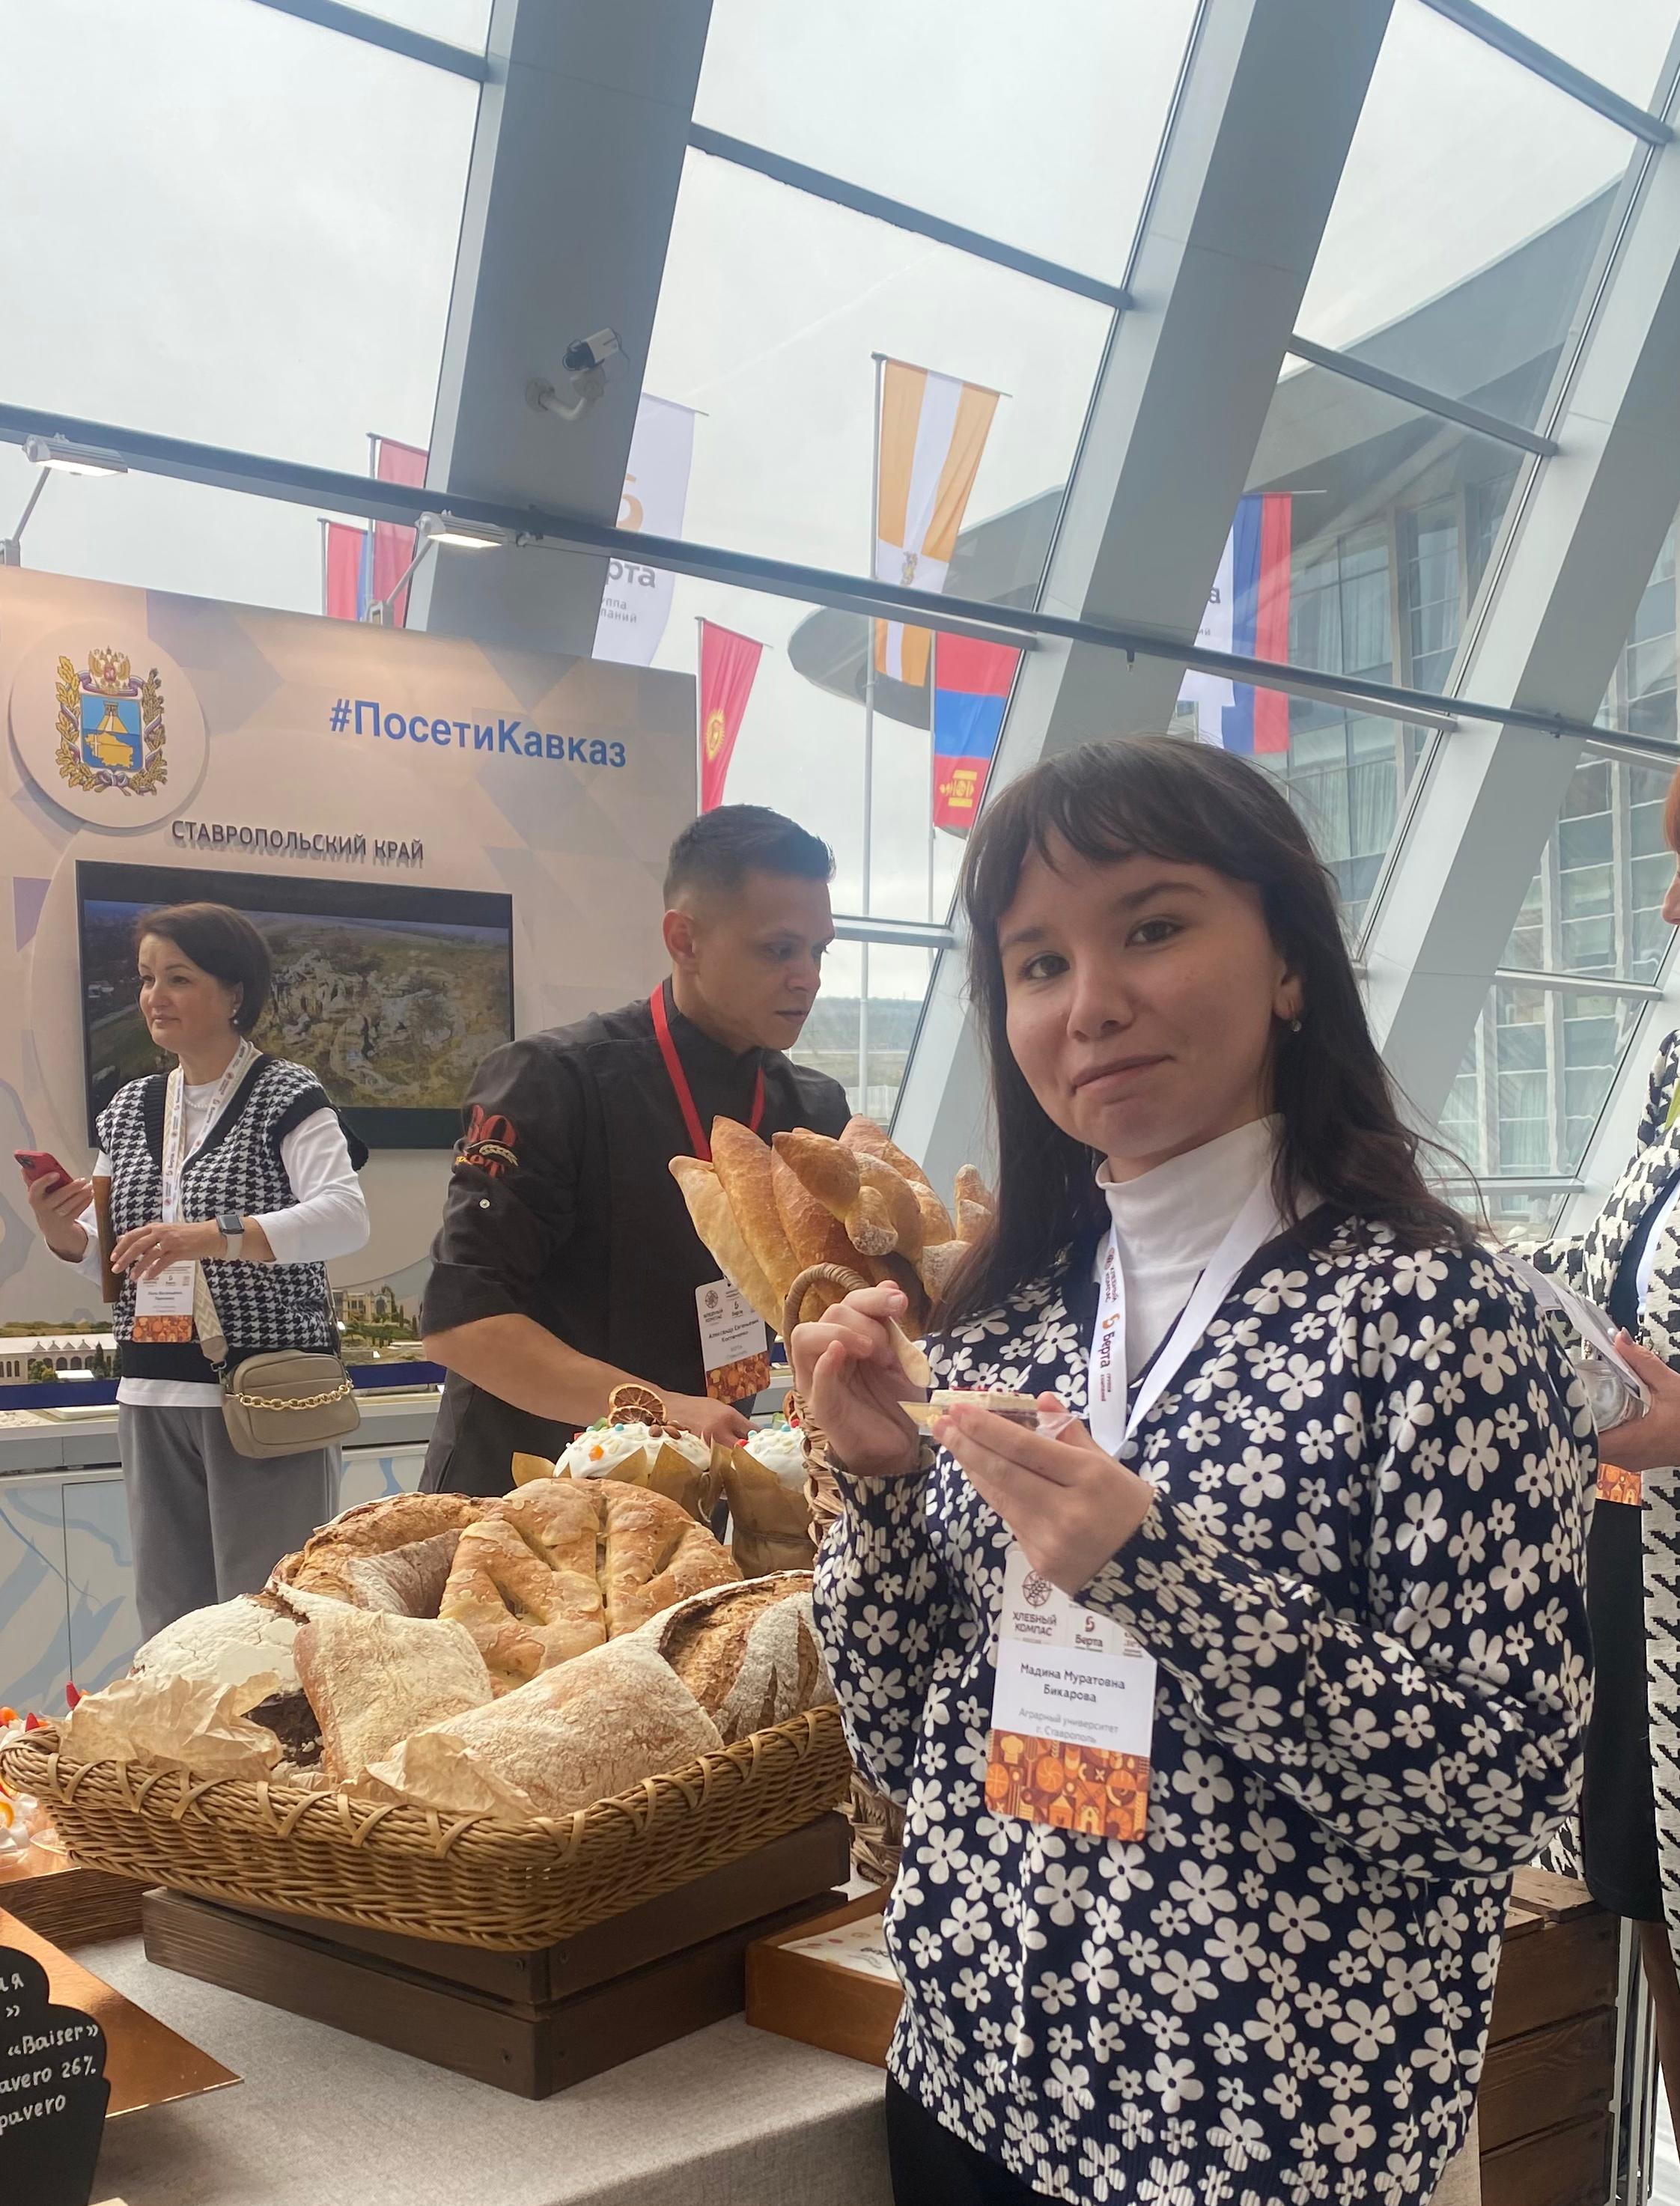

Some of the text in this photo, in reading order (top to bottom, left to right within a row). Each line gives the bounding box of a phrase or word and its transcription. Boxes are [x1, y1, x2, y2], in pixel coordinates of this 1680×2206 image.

[606, 561, 656, 589] рта
[600, 607, 637, 624] паний
[603, 597, 627, 611] ппа
[329, 698, 627, 768] #ПосетиКавказ
[171, 820, 424, 861] СТАВРОПОЛЬСКИЙ КРАЙ
[1098, 1330, 1116, 1369] Берта
[1011, 1611, 1058, 1627] ХЛЕБНЫЙ
[1014, 1622, 1053, 1637] КОМПАС
[1074, 1633, 1104, 1648] Берта
[1020, 1663, 1126, 1690] Мадина Муратовна
[1043, 1684, 1098, 1703] Бикарова
[1018, 1707, 1119, 1734] Аграрный университет
[1044, 1725, 1098, 1744] Ставрополь
[7, 2023, 99, 2057] «Baiser»
[0, 2067, 52, 2094] avero
[0, 2094, 67, 2135] pavero
